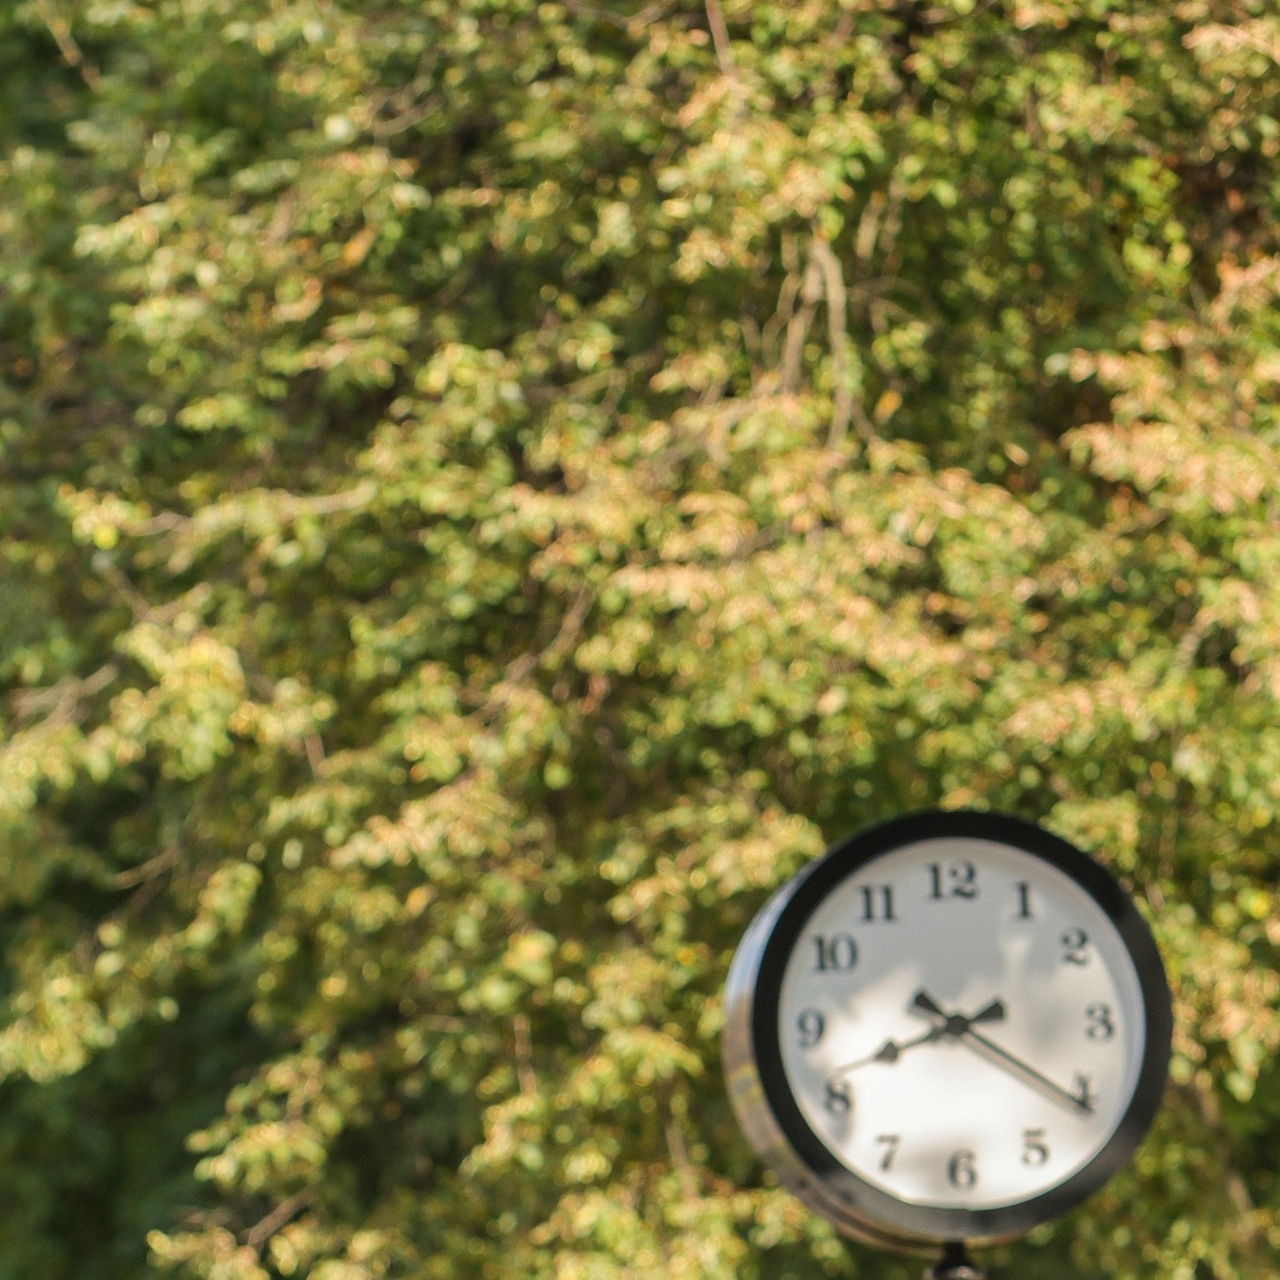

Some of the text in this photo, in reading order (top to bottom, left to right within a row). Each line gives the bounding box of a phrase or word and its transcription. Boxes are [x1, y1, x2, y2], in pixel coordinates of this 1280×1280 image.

[926, 860, 978, 901] 12
[859, 885, 896, 922] 11
[1014, 883, 1034, 919] 1
[811, 933, 859, 973] 10
[1060, 927, 1090, 966] 2
[797, 1008, 825, 1048] 9
[1086, 1003, 1114, 1042] 3
[823, 1076, 852, 1115] 8
[876, 1134, 901, 1172] 7
[1021, 1129, 1049, 1168] 5
[948, 1149, 978, 1189] 6
